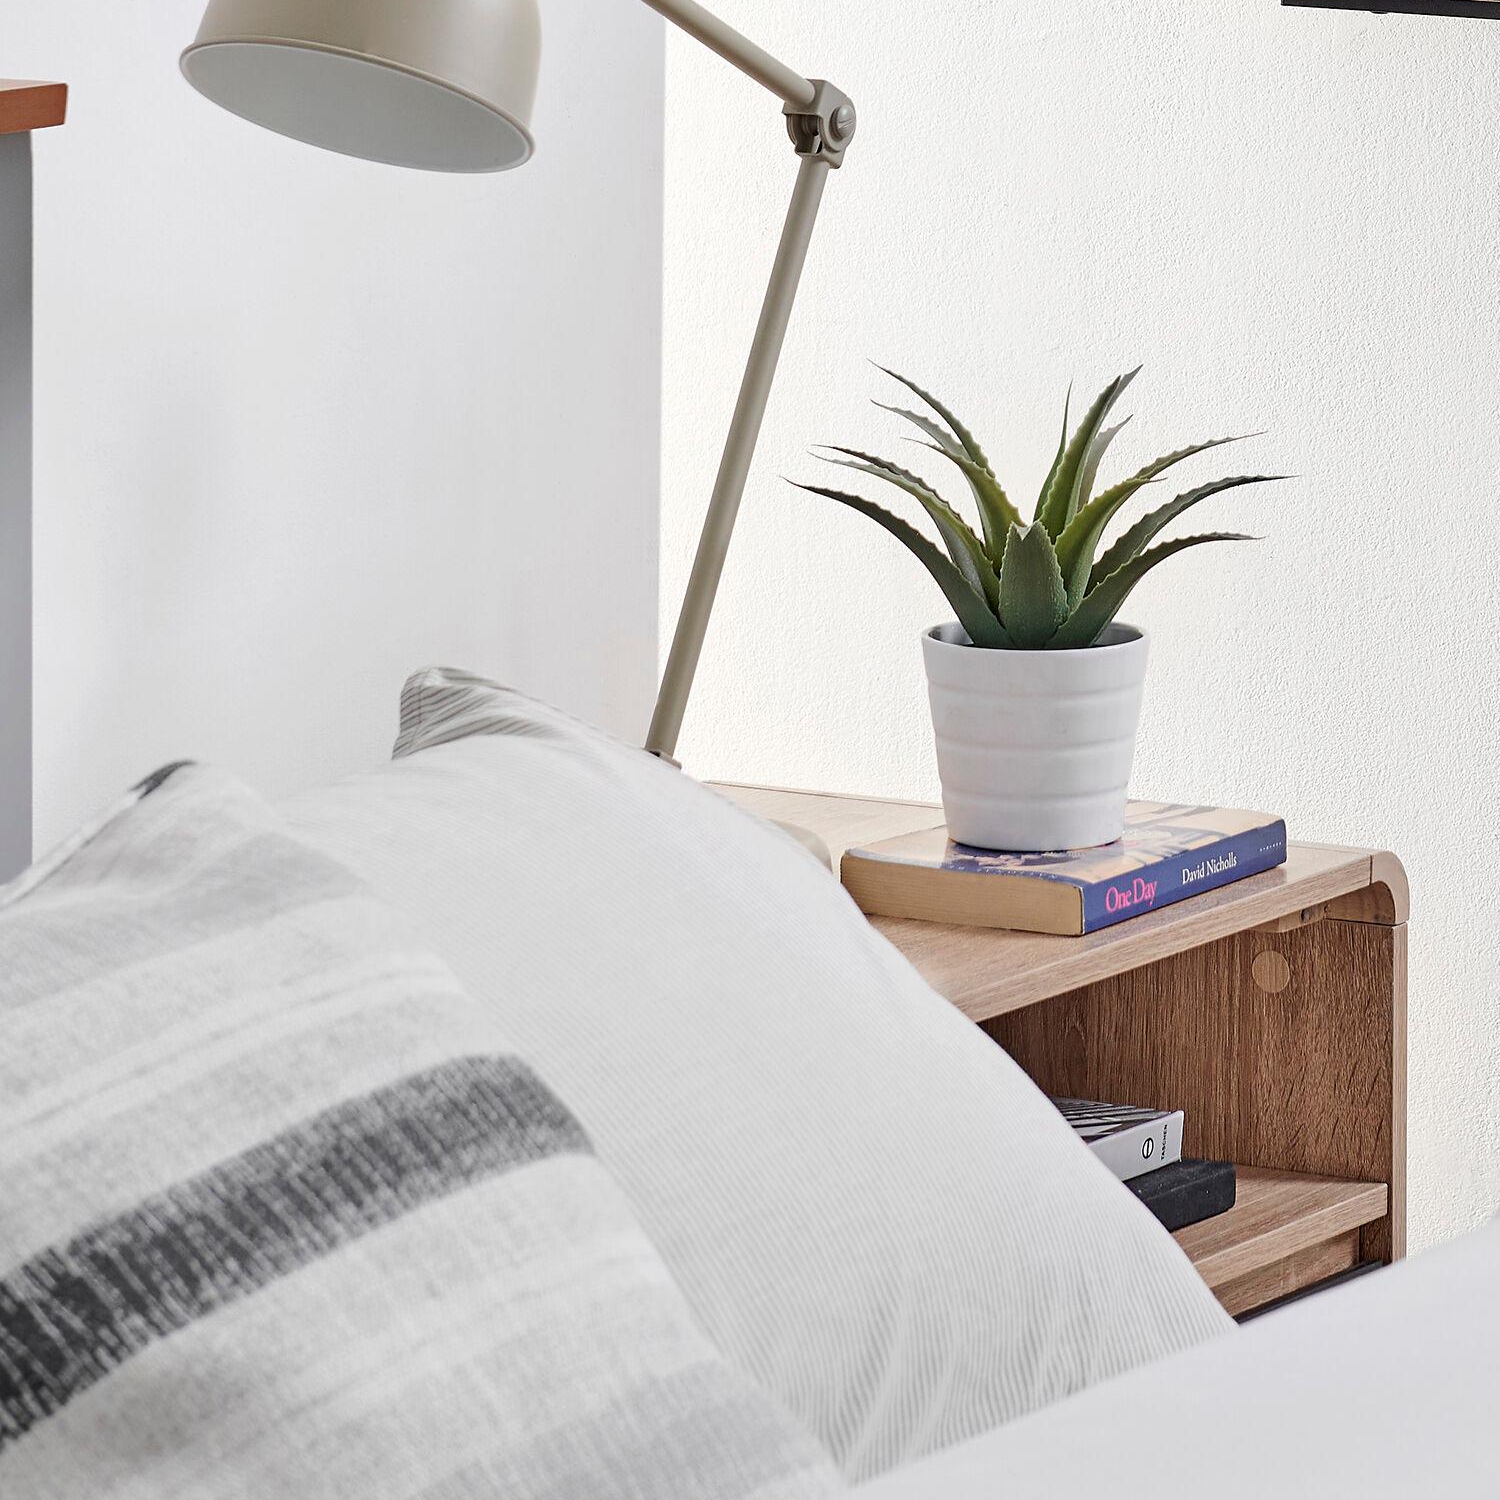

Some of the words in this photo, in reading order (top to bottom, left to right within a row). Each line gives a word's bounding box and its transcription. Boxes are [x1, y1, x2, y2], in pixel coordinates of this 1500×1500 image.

[1182, 862, 1205, 885] David
[1206, 852, 1237, 877] Nicholls
[1105, 886, 1131, 913] One
[1132, 877, 1157, 906] Day
[1160, 1124, 1168, 1161] TASCHEN
